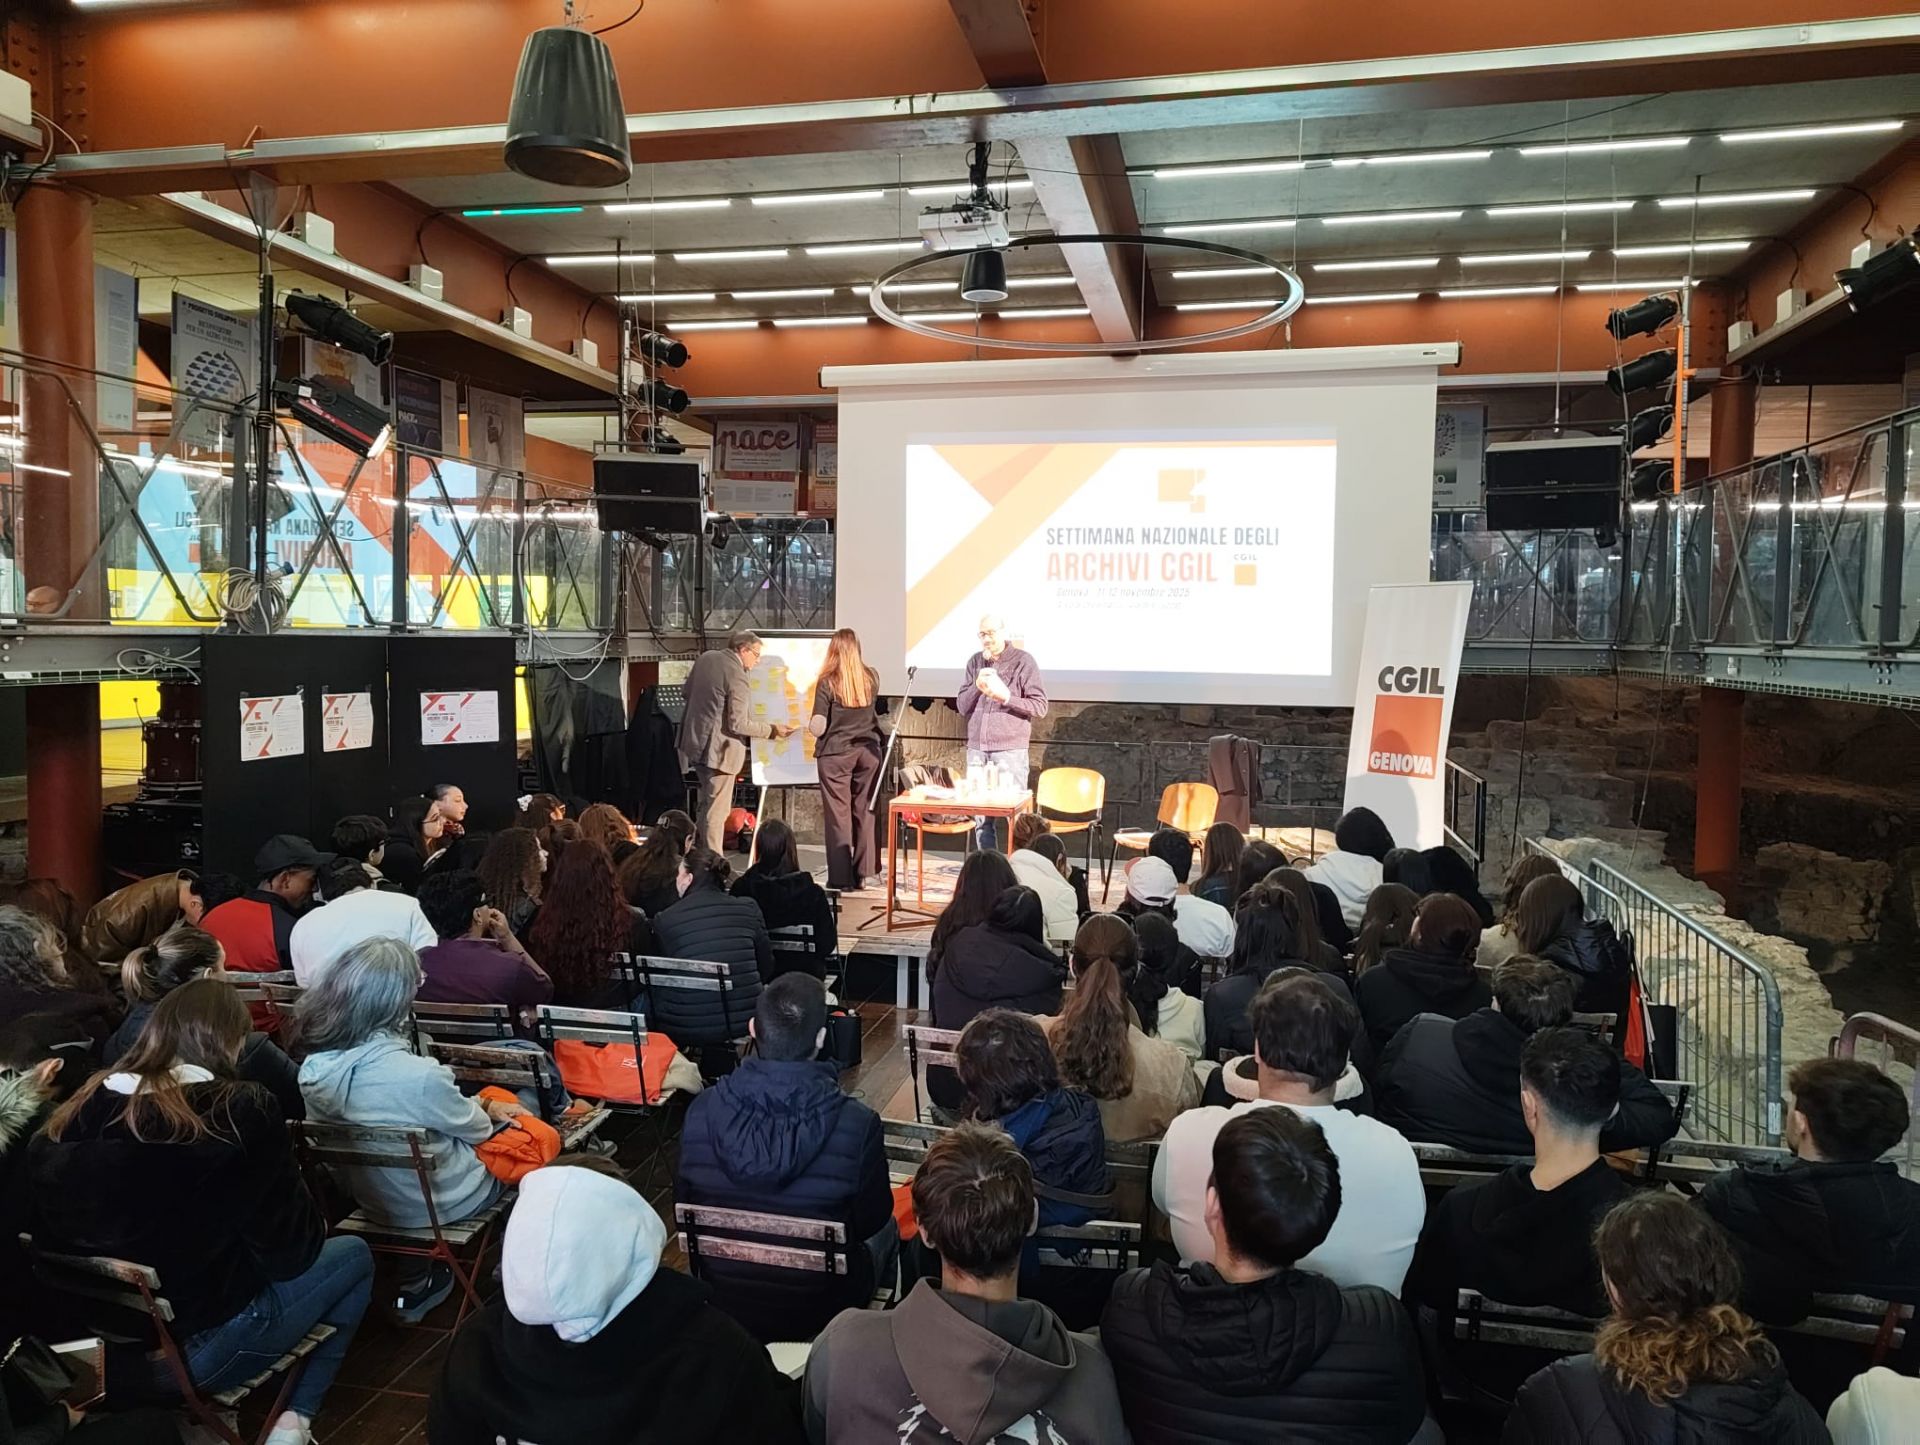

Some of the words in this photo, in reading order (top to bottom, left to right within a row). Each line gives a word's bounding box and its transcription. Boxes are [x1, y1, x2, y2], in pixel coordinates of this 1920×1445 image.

[715, 429, 798, 470] pace
[1046, 526, 1135, 546] SETTIMANA
[1141, 526, 1228, 546] NAZIONALE
[1233, 526, 1280, 546] DEGLI
[1046, 551, 1150, 582] ARCHIVI
[1160, 551, 1218, 582] CGIL
[1233, 553, 1258, 561] CGIL
[1378, 665, 1445, 695] CGIL
[1369, 751, 1434, 776] GENOVA
